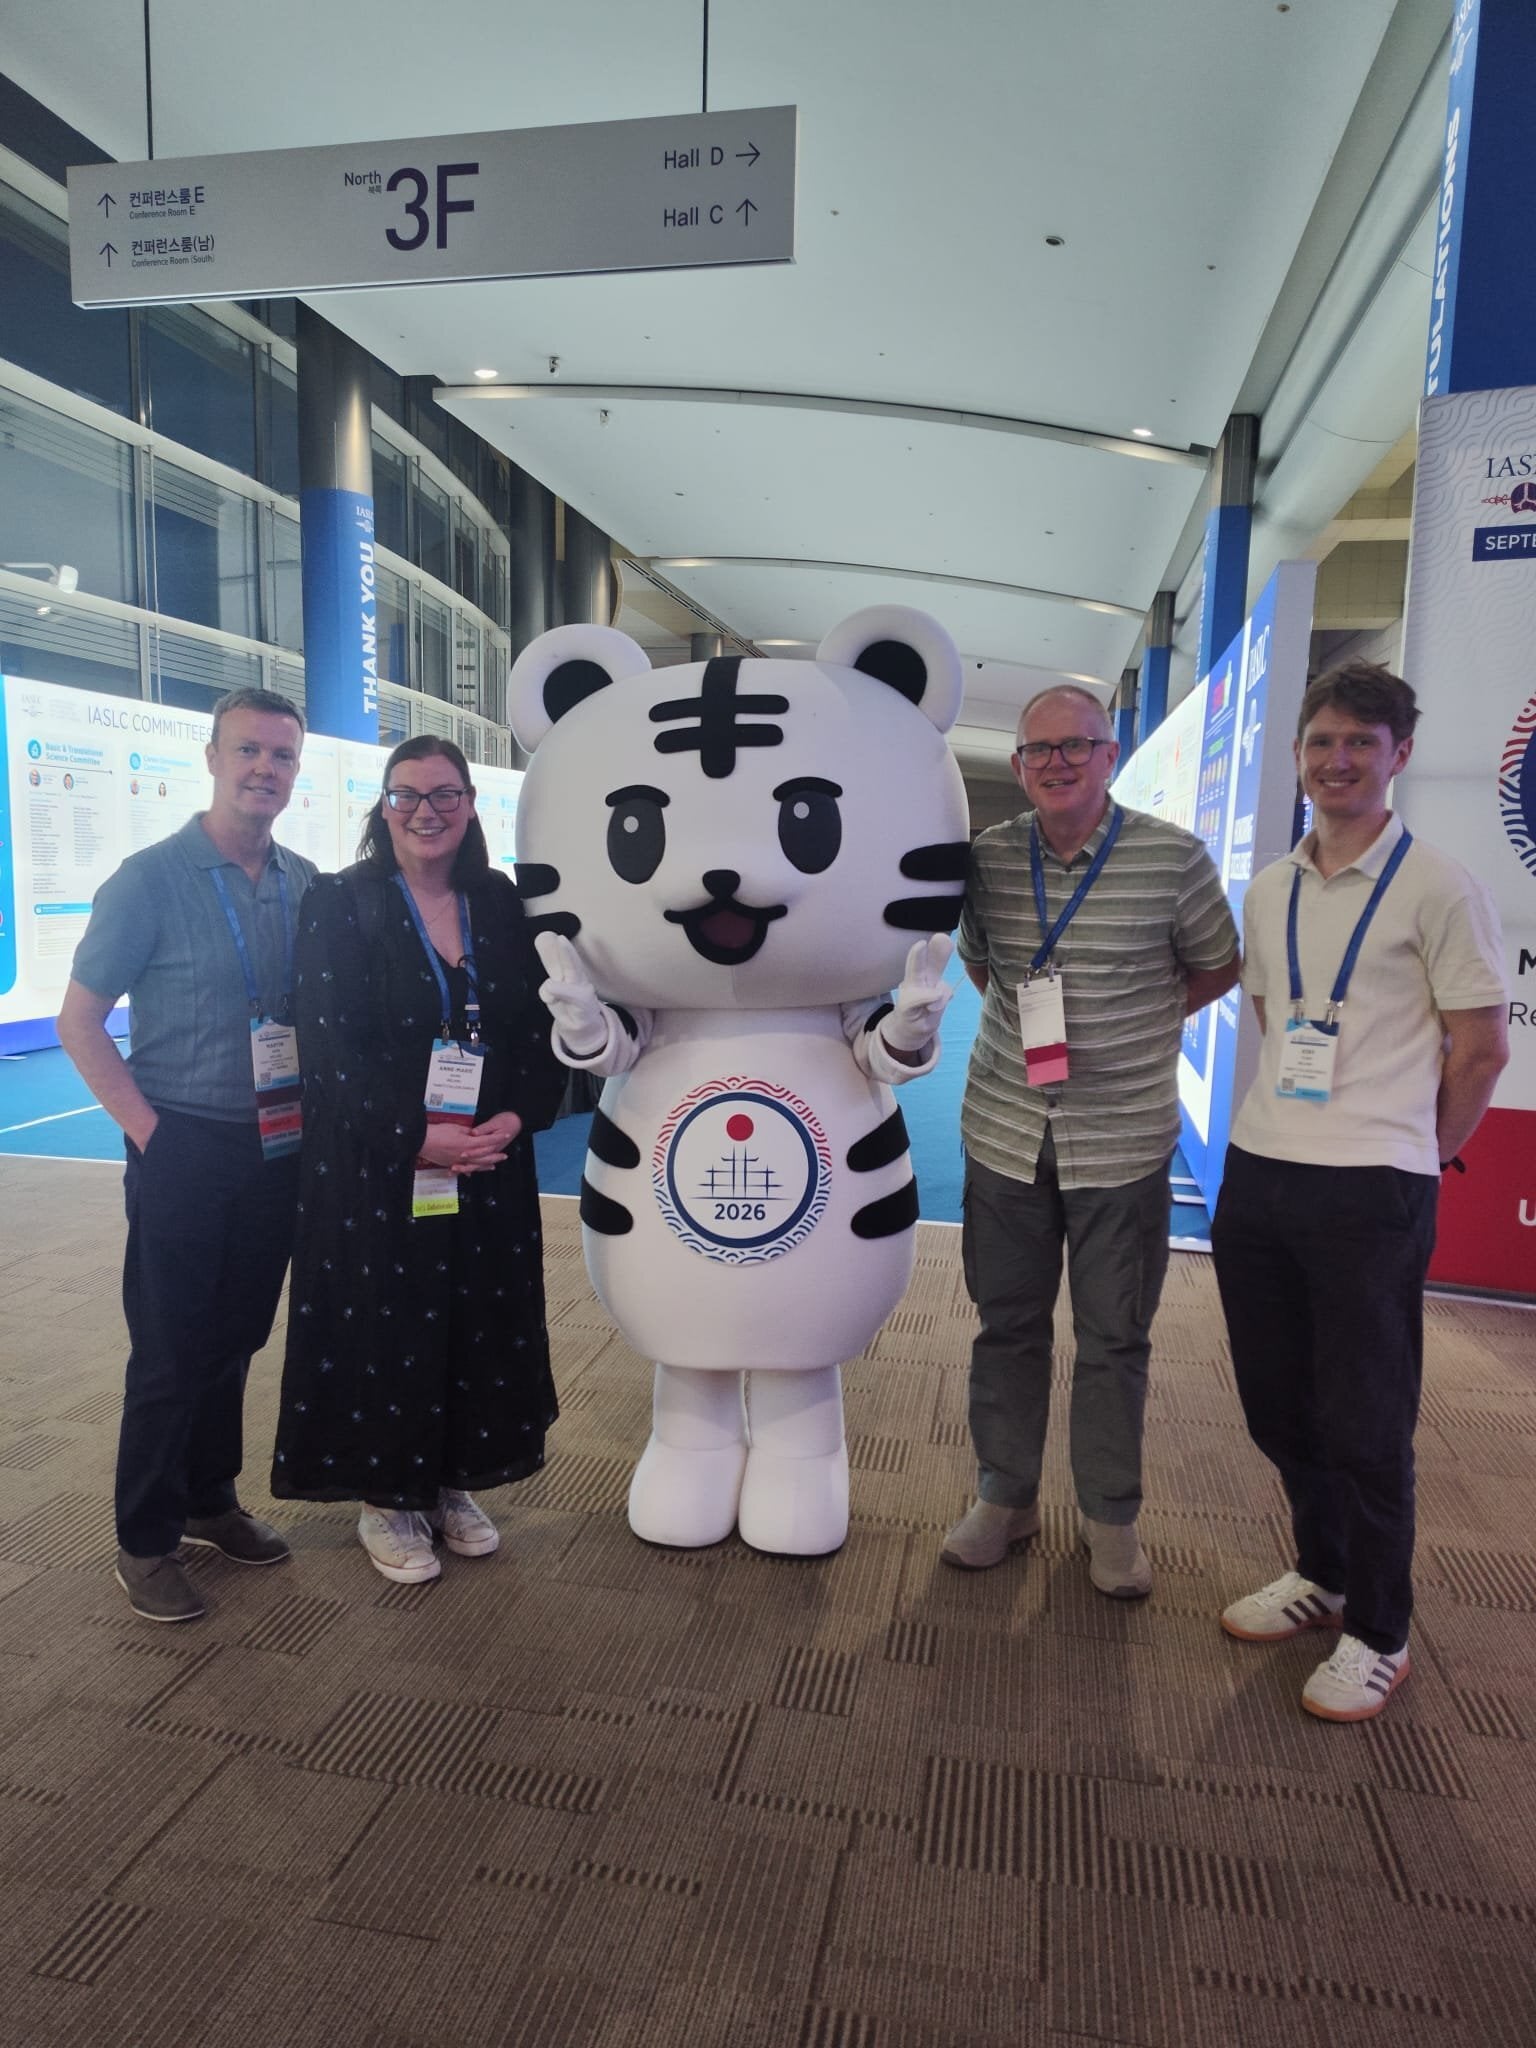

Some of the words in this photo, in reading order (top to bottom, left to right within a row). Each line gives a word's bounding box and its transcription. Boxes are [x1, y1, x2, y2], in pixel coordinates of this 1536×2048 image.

[664, 147, 699, 170] Hall
[710, 146, 724, 166] D
[344, 170, 382, 187] North
[129, 187, 191, 208] 컨퍼런스룸
[194, 185, 205, 204] E
[385, 162, 479, 251] 3F
[129, 209, 166, 220] Conference
[167, 207, 187, 217] Room
[189, 205, 196, 216] E
[663, 206, 699, 228] Hall
[709, 204, 724, 225] C
[131, 234, 215, 256] 컨퍼런스룸(남)
[131, 258, 169, 268] Conference
[169, 256, 190, 265] Room
[191, 254, 215, 264] (South)
[1485, 454, 1536, 479] IAS
[359, 541, 376, 604] YOU
[361, 611, 378, 714] THANK
[88, 705, 129, 730] IASLC
[132, 713, 213, 744] COMMITTEES
[714, 1203, 766, 1221] 2026
